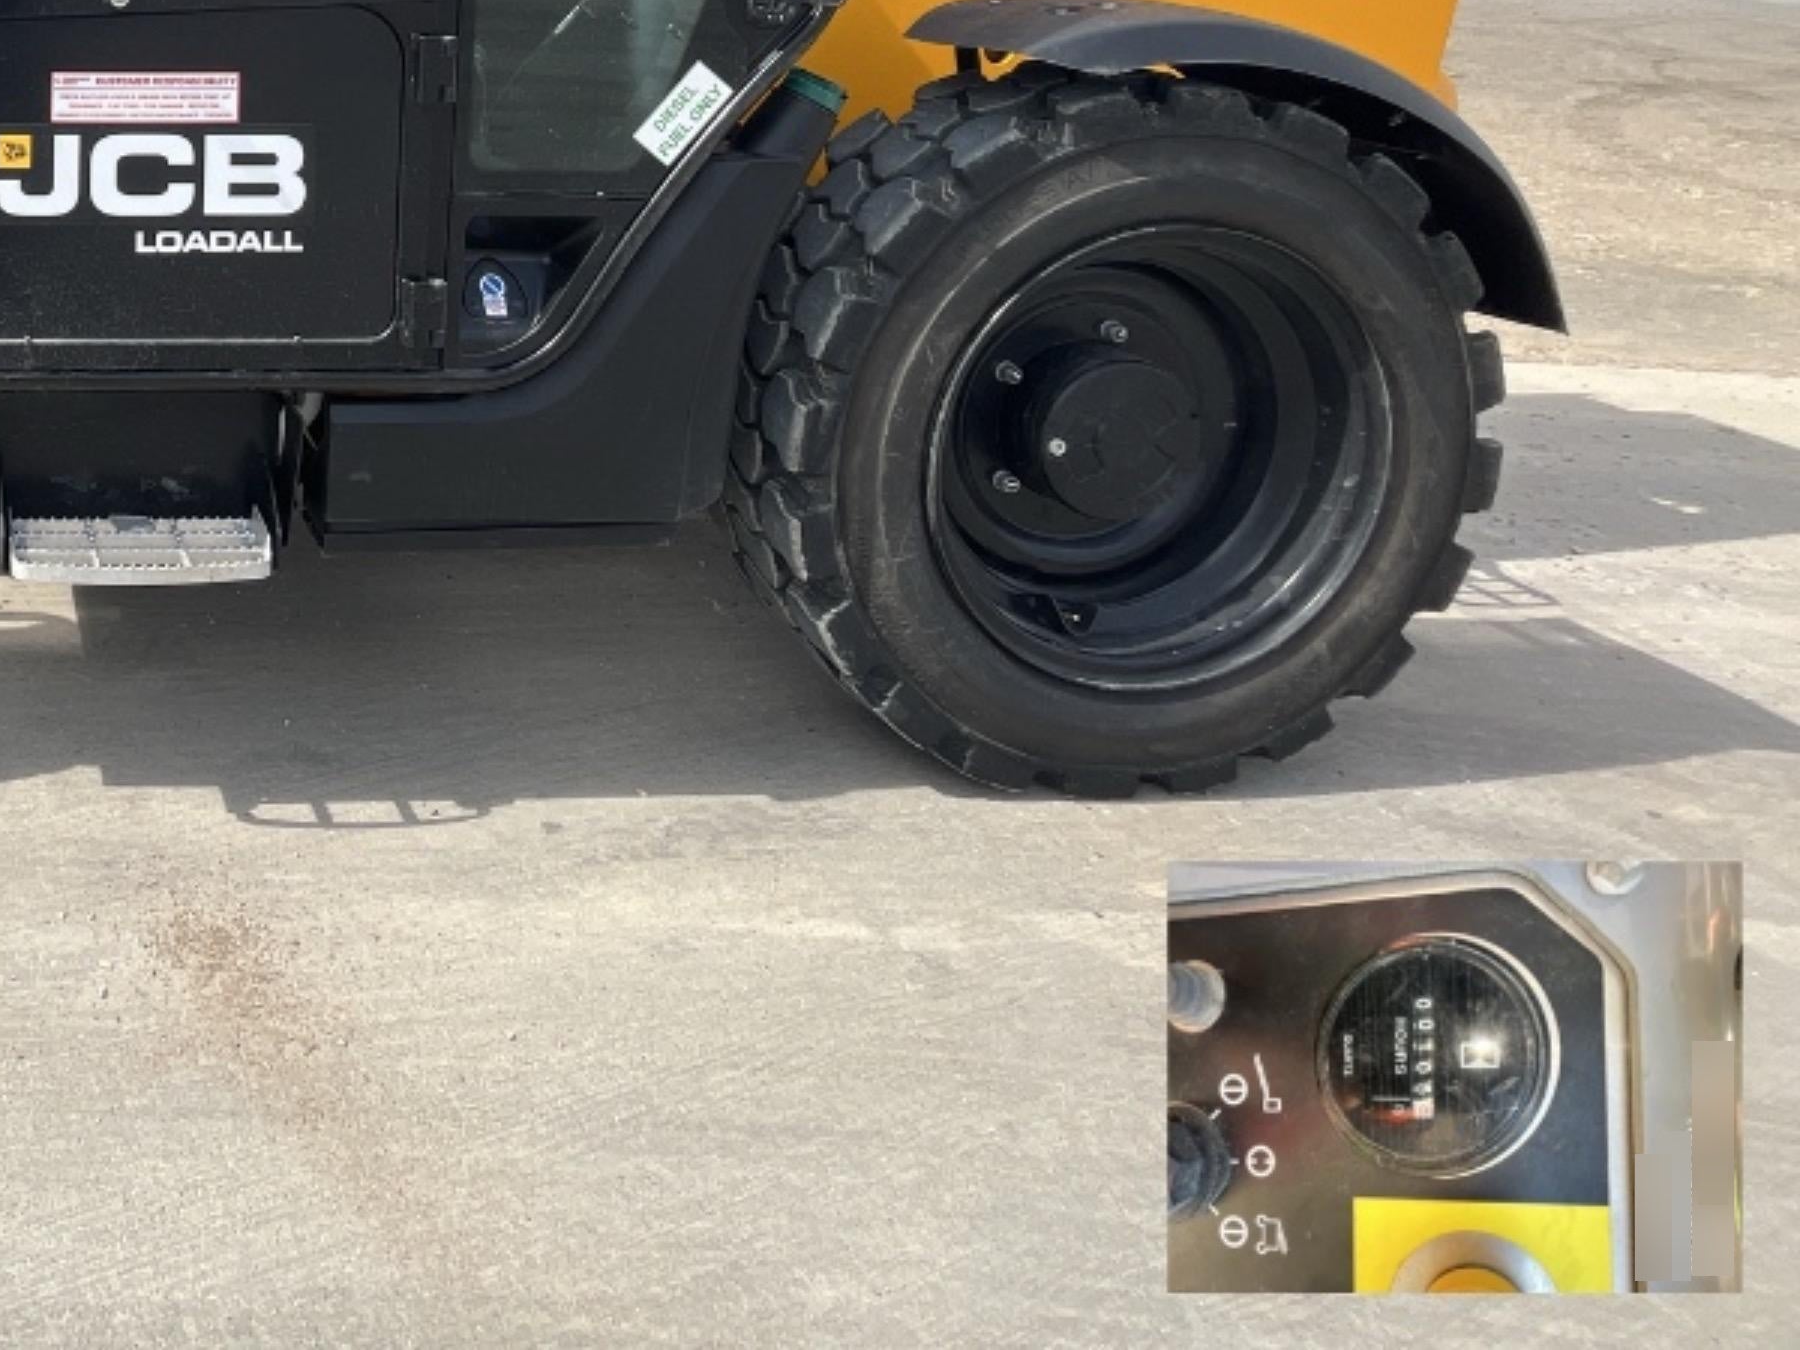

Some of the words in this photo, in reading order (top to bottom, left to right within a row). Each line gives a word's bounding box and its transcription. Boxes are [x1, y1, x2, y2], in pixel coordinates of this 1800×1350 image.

[653, 86, 698, 132] DIESEL
[658, 123, 694, 157] FUEL
[688, 83, 721, 122] ONLY
[134, 230, 304, 254] LOADALL
[1394, 1016, 1408, 1075] HOURS
